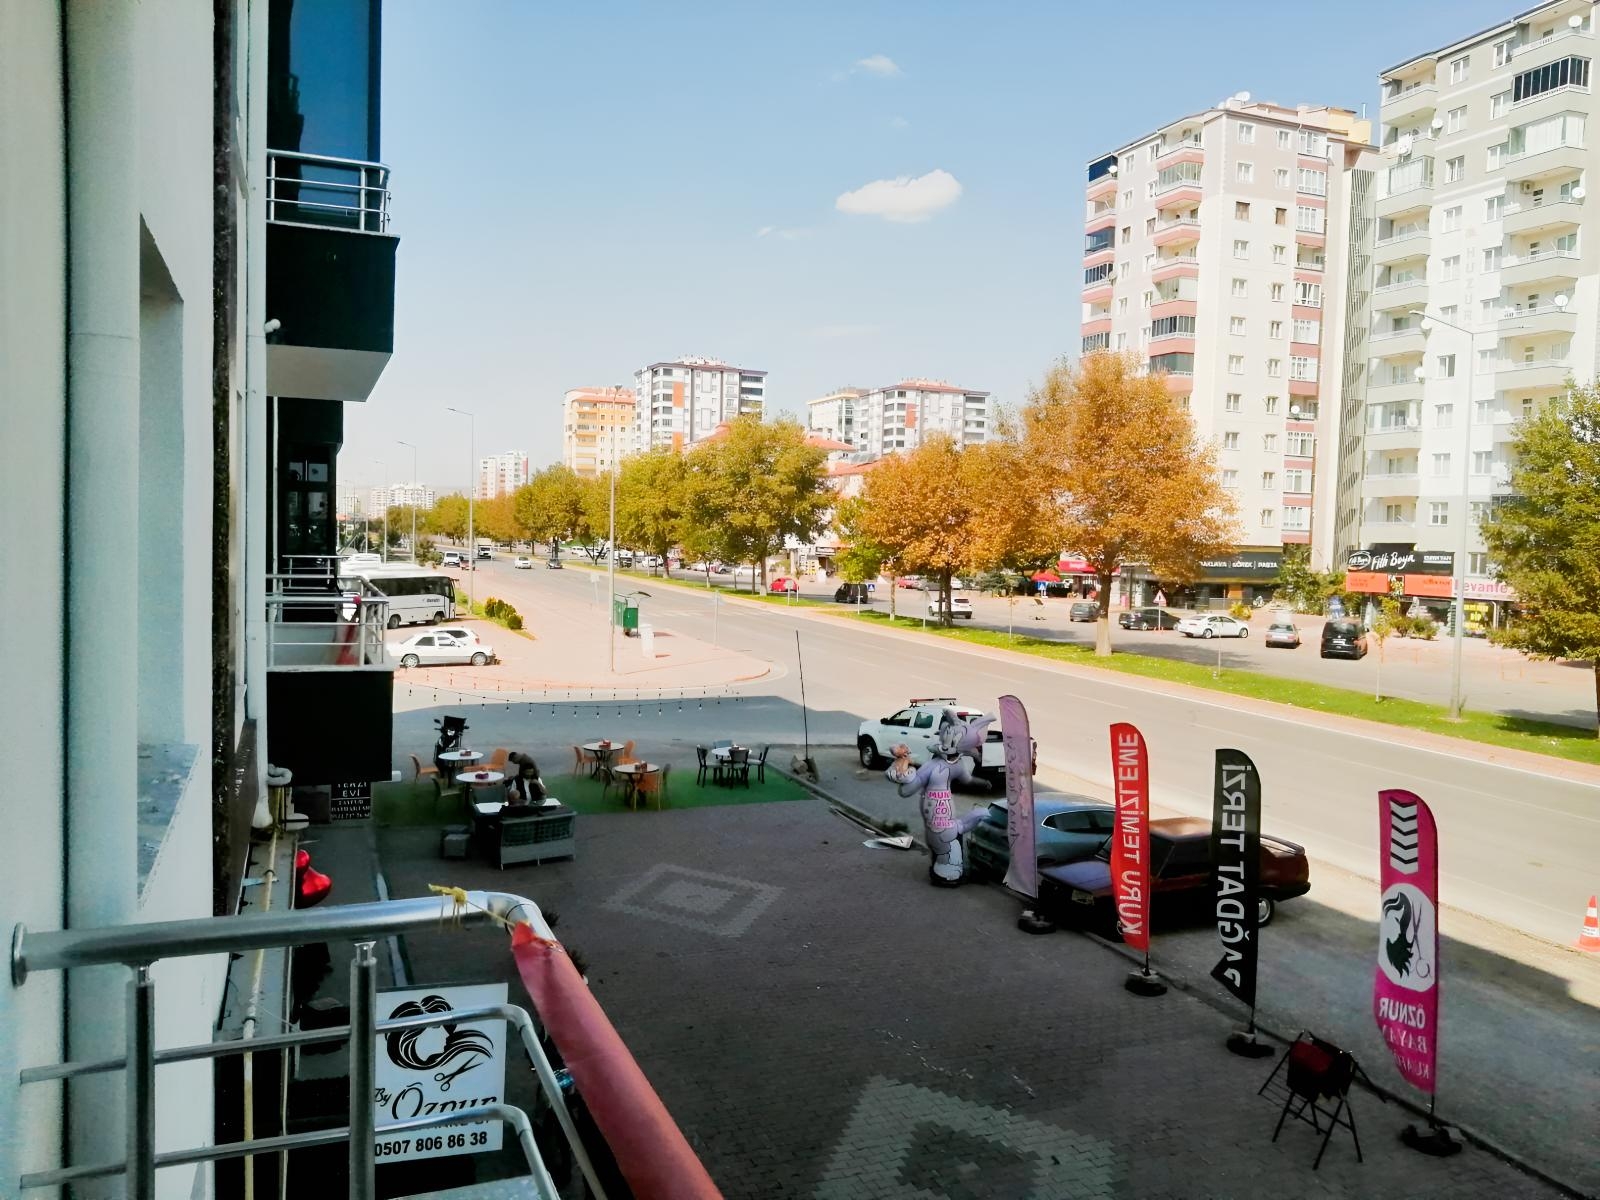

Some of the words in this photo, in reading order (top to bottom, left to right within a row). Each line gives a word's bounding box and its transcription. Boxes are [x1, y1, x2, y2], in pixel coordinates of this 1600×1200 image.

[1371, 553, 1389, 570] Filli
[1390, 552, 1415, 570] Boya
[375, 1087, 392, 1107] By
[375, 1140, 411, 1157] 0507
[415, 1136, 442, 1152] 806
[447, 1134, 465, 1149] 86
[470, 1131, 487, 1146] 38
